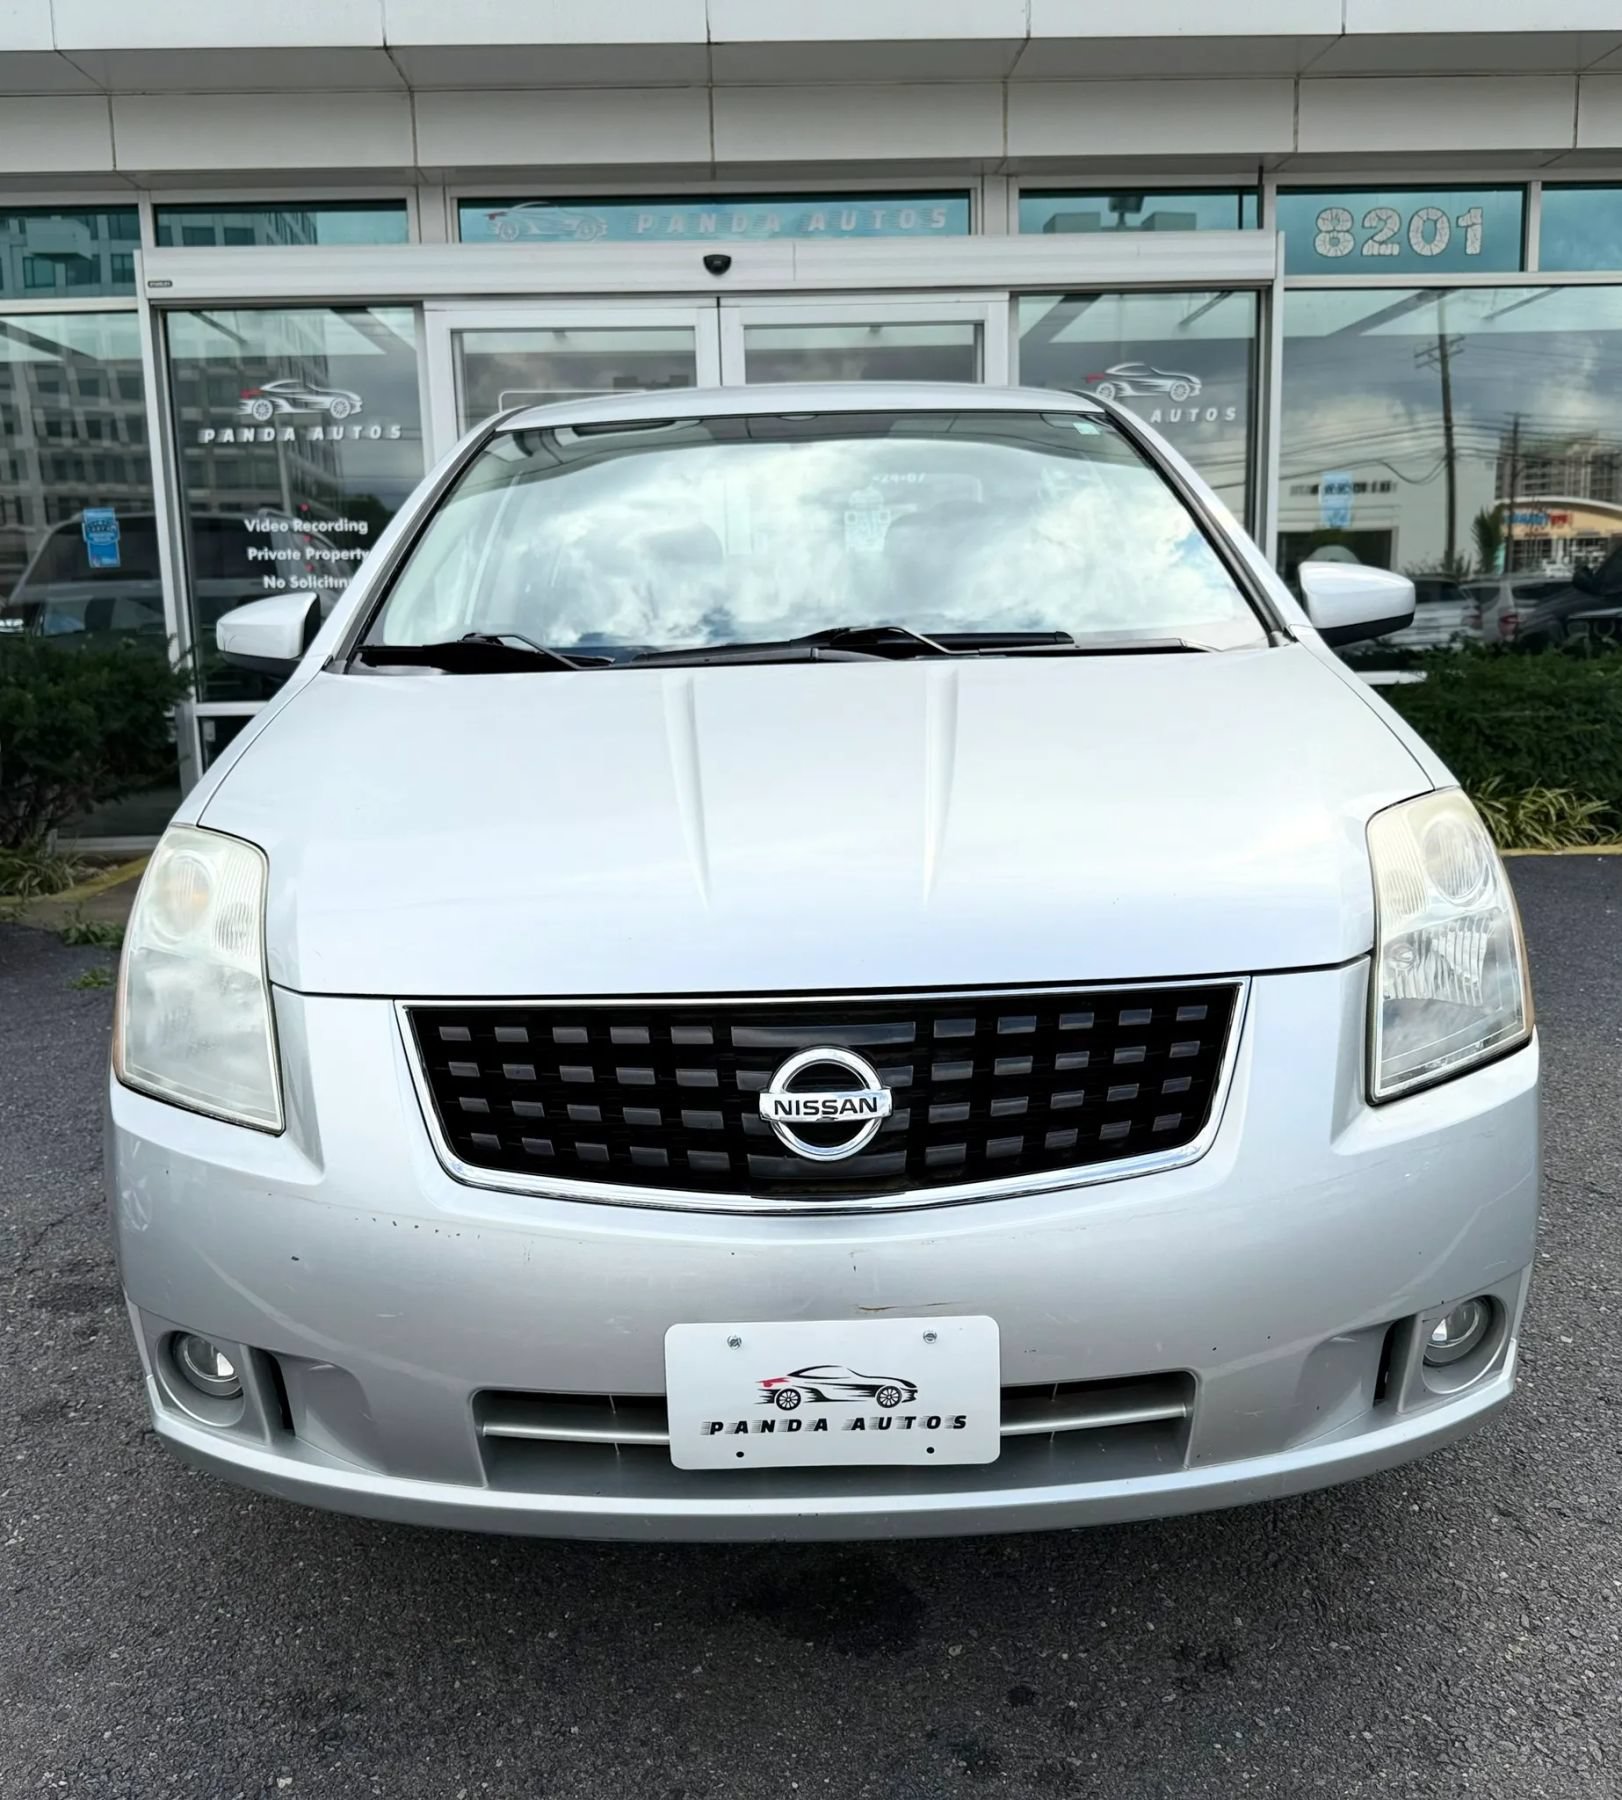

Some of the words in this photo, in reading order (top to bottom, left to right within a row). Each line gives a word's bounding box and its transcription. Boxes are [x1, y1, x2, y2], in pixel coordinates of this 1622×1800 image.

[633, 212, 781, 235] PANDA
[807, 207, 947, 233] AUTOS
[1313, 206, 1483, 258] 8201
[1150, 407, 1237, 423] AUTOS
[198, 426, 296, 443] PANDA
[308, 424, 402, 441] AUTOS
[244, 519, 290, 533] Video
[293, 518, 368, 535] Recording
[247, 546, 302, 561] Private
[263, 576, 286, 589] No
[289, 574, 352, 590] Solicitin
[774, 1097, 878, 1116] NISSAN
[702, 1418, 829, 1436] PANDA
[842, 1415, 968, 1432] AUTOS
